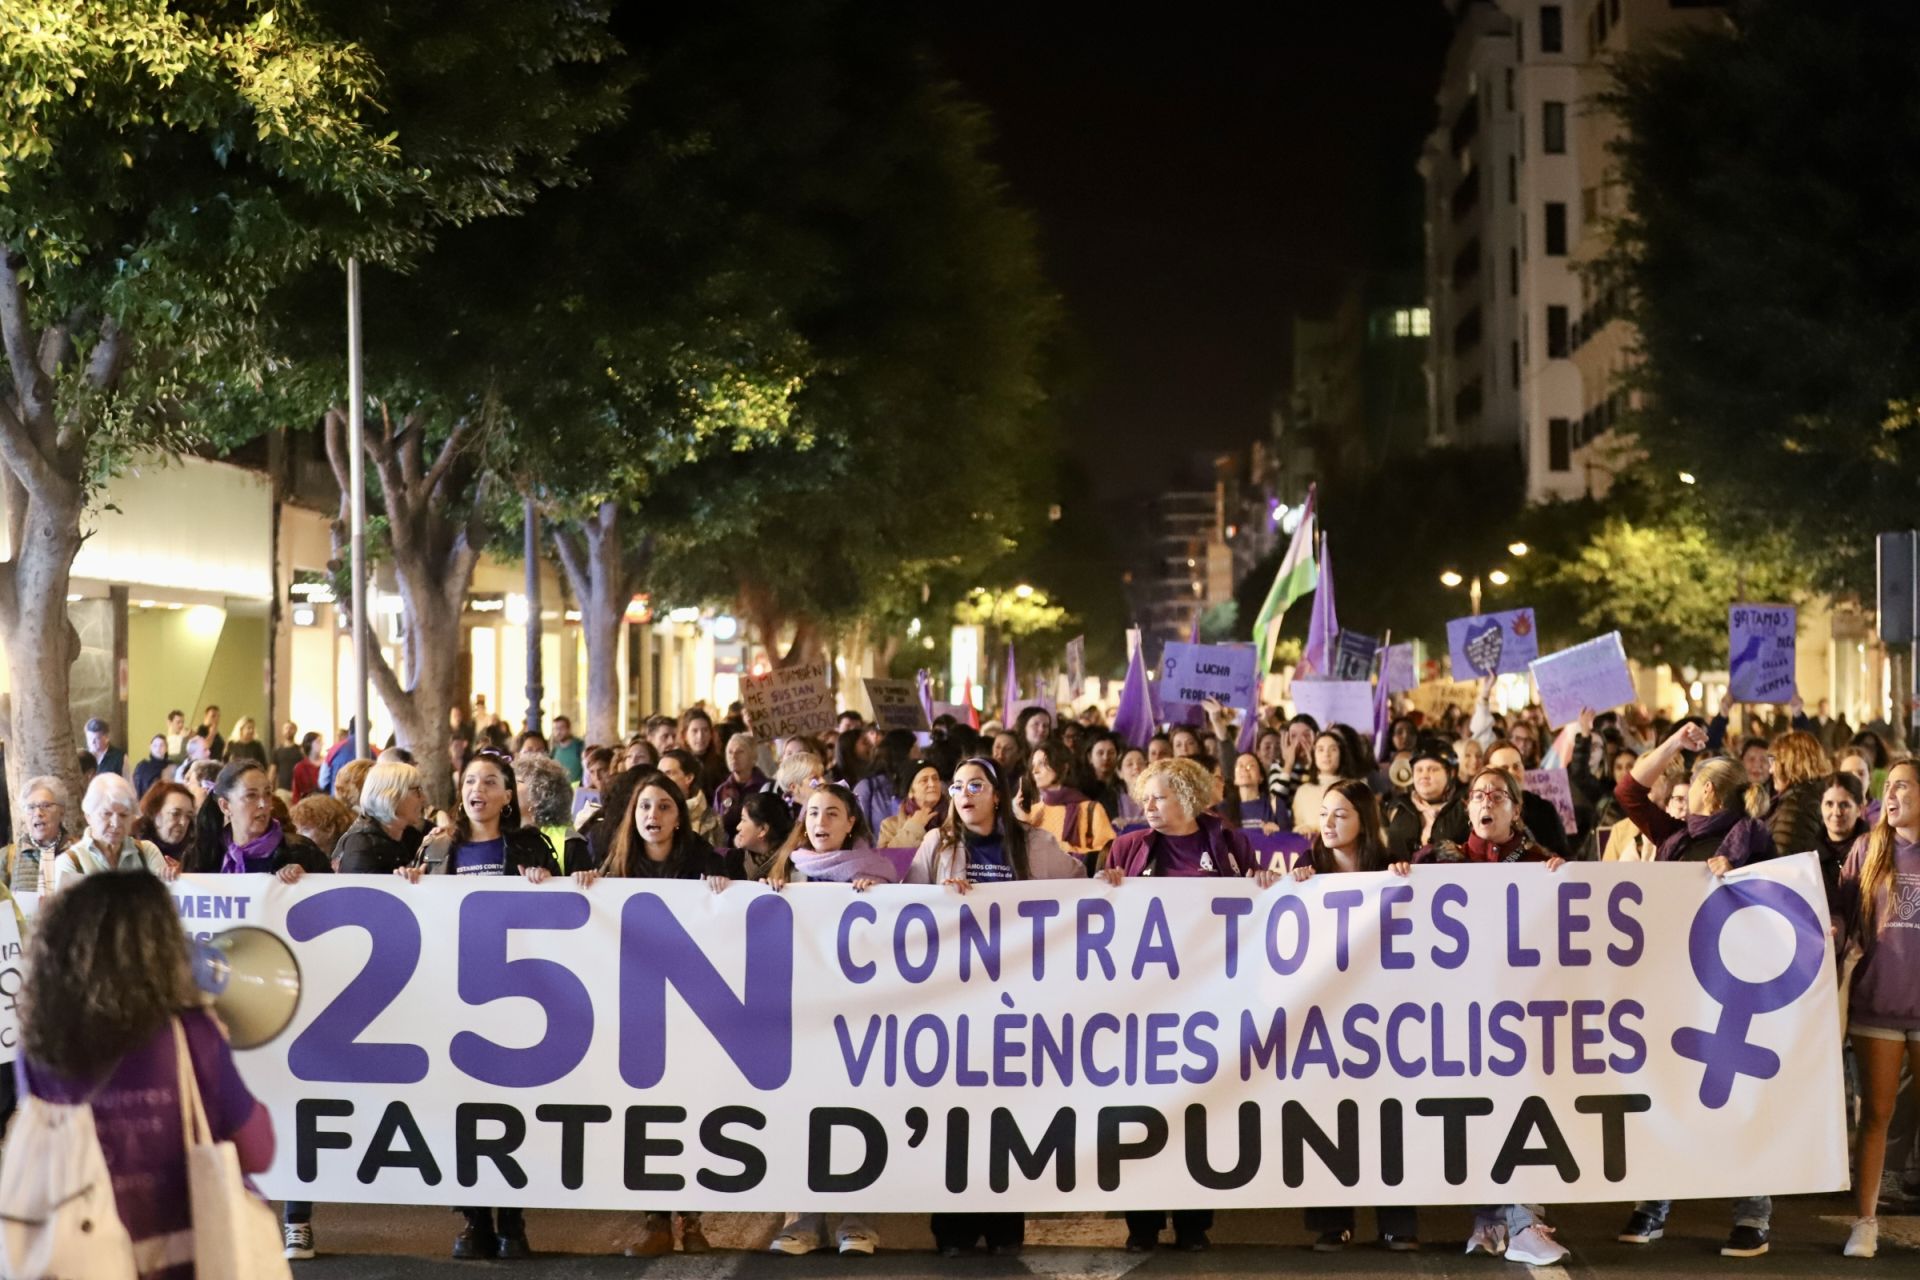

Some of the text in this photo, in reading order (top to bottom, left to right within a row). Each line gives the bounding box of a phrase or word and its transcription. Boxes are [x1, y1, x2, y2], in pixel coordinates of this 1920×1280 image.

[748, 691, 764, 704] ME
[1195, 662, 1231, 677] LUCHA
[751, 707, 769, 722] LAS
[753, 722, 772, 739] NO
[773, 716, 798, 737] LAS
[837, 880, 1645, 985] CONTRA TOTES LES
[286, 887, 794, 1091] 25N
[834, 991, 1648, 1088] VIOLÈNCIES MASCLISTES
[296, 1098, 768, 1193] FARTES
